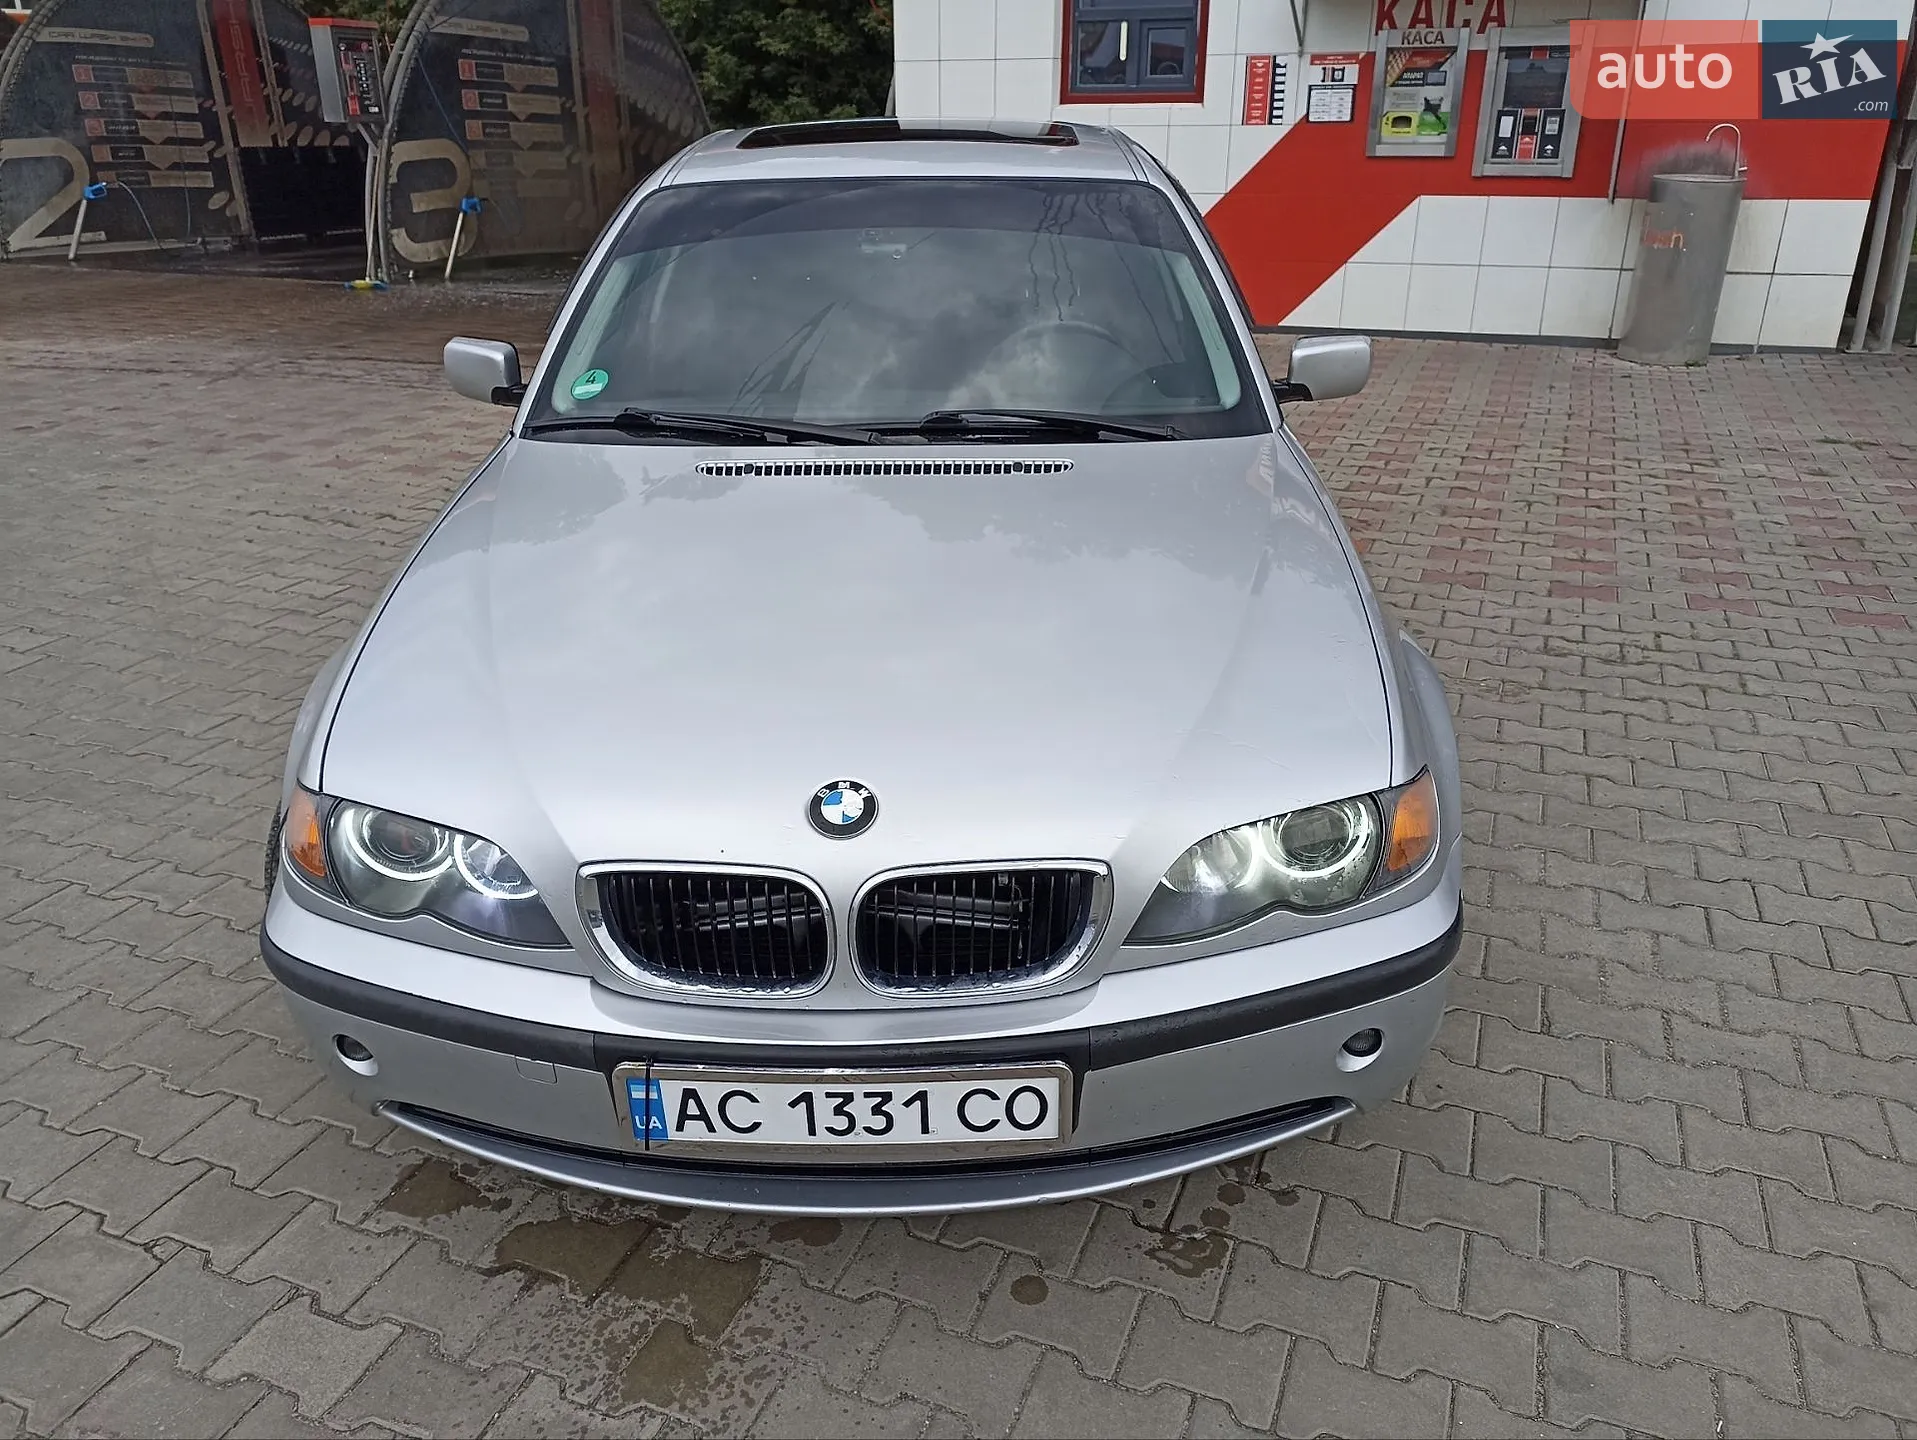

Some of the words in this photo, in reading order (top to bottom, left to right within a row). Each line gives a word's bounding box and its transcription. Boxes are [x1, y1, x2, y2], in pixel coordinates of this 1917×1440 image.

[1401, 31, 1445, 45] КАСА
[0, 137, 107, 252] 2
[389, 138, 478, 262] 3
[585, 371, 597, 385] 4
[634, 1114, 663, 1131] UA
[675, 1087, 762, 1134] AC
[787, 1089, 933, 1137] 1331
[956, 1085, 1049, 1133] CO
